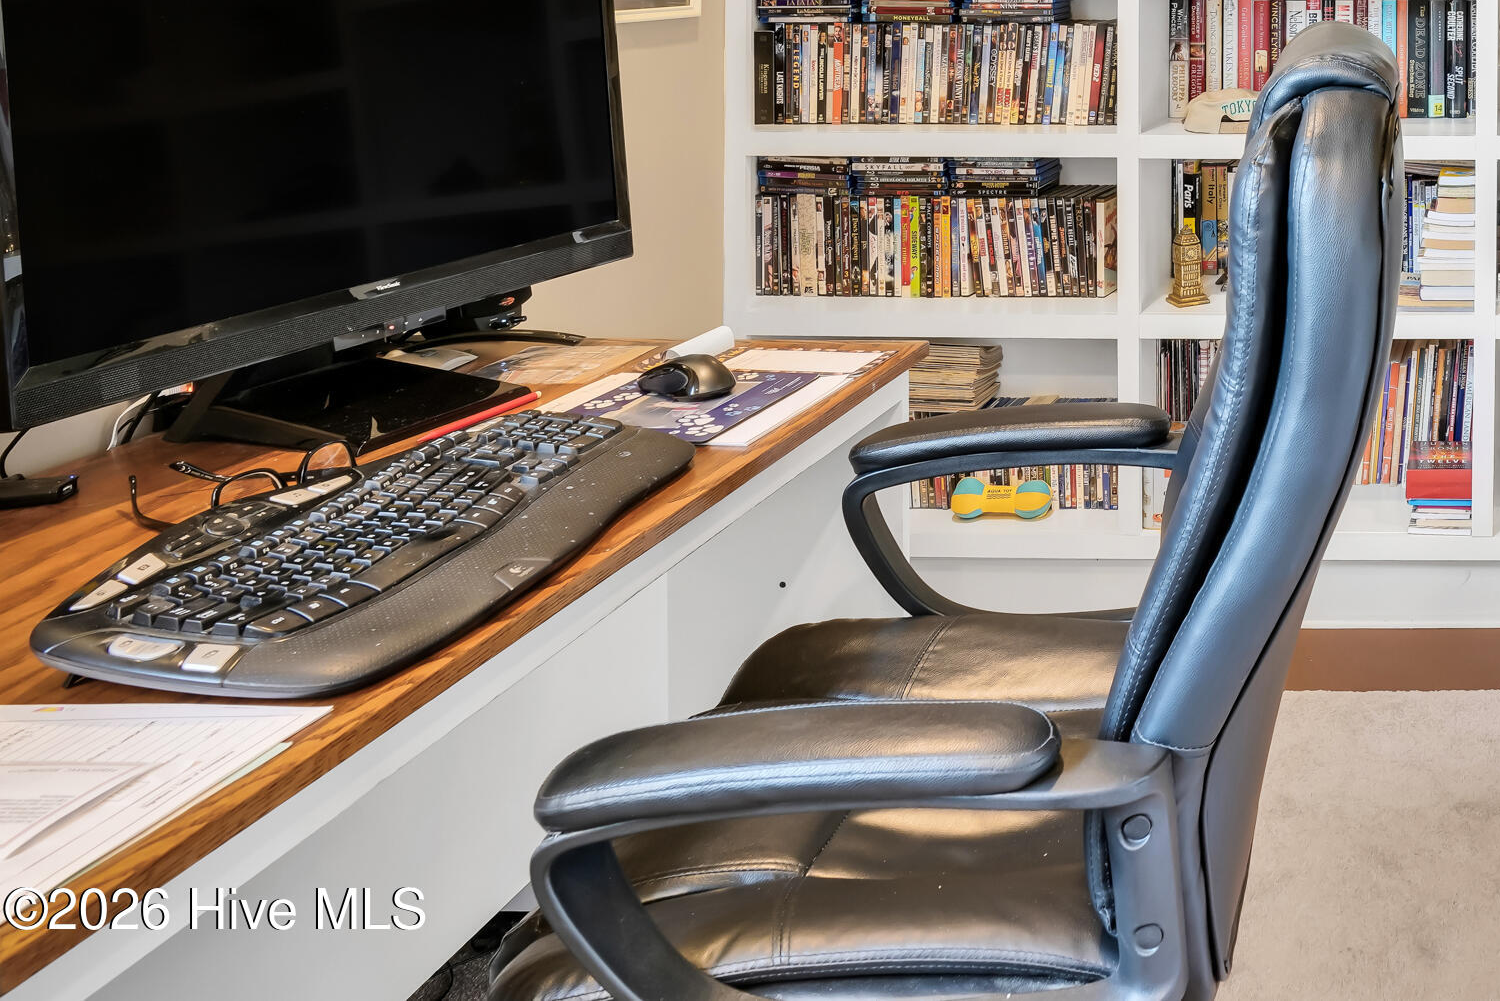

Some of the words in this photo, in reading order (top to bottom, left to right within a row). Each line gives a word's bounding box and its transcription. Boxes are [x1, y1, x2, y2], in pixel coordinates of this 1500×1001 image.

[1170, 2, 1178, 36] PRINCESS
[1288, 10, 1303, 38] Nelson
[1447, 11, 1456, 41] COULTER
[1456, 11, 1464, 41] CATHERINE
[792, 49, 800, 89] LEGEND
[1455, 65, 1464, 85] SPLIT
[1446, 73, 1455, 99] SECOND
[1184, 184, 1194, 209] Paris
[1207, 184, 1215, 205] Italy
[1050, 215, 1058, 240] TROPIC
[1075, 205, 1083, 228] TROY
[1052, 241, 1061, 272] THUNDER
